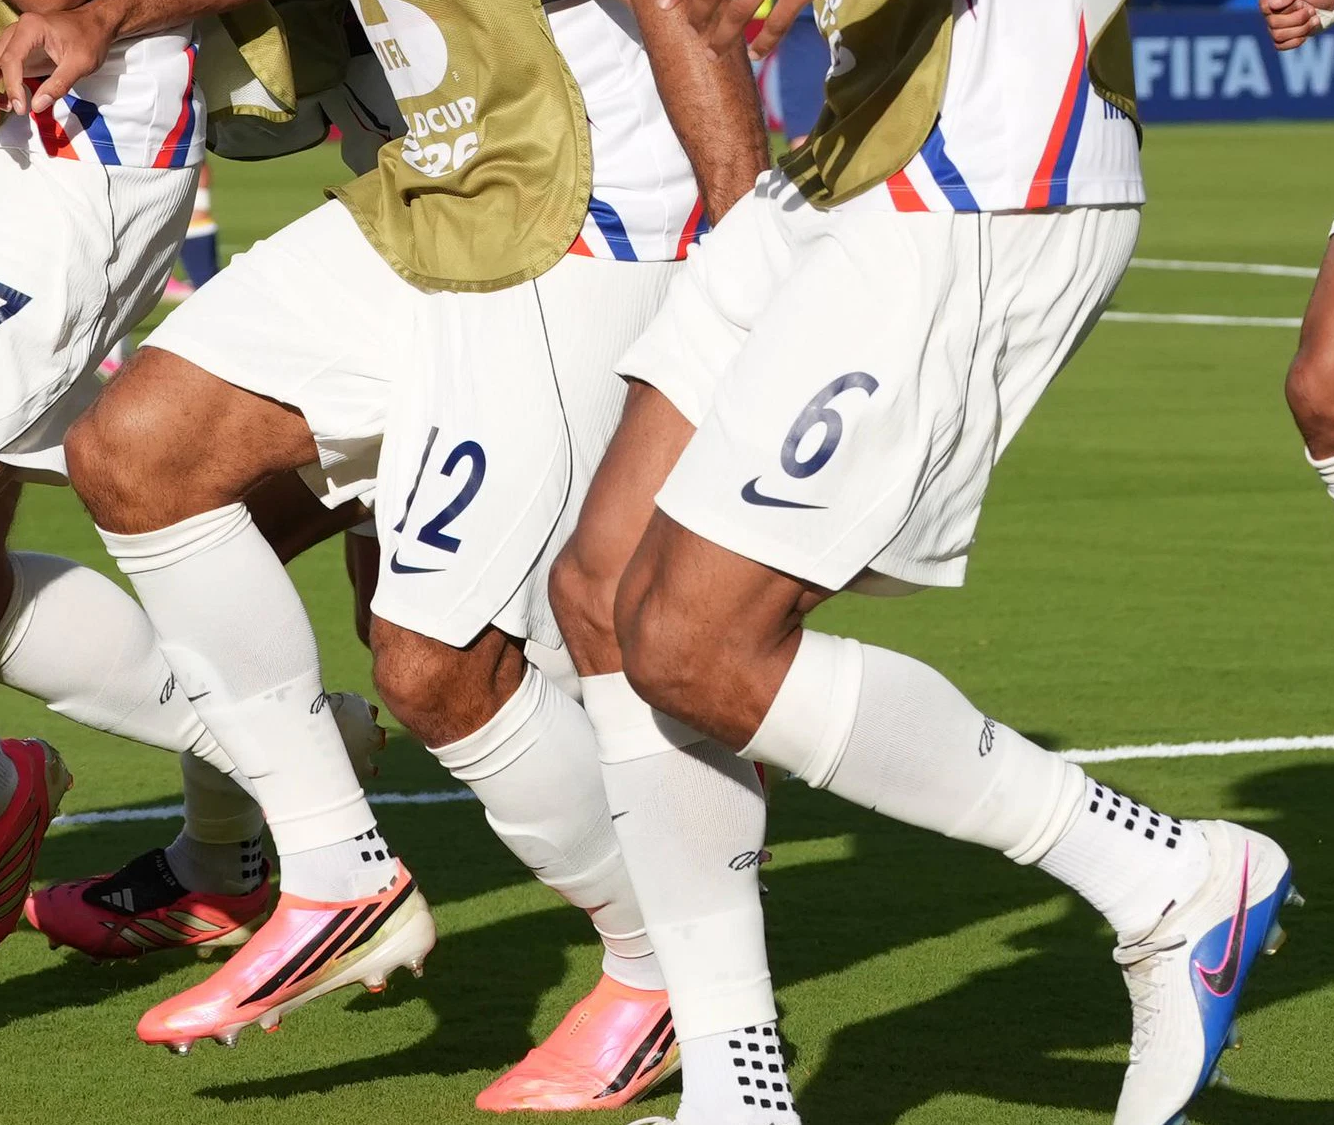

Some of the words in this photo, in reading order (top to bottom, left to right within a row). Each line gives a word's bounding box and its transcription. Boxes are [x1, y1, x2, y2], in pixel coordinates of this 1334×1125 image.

[1134, 35, 1273, 100] FIFA
[780, 371, 880, 480] 6
[393, 426, 487, 554] 12
